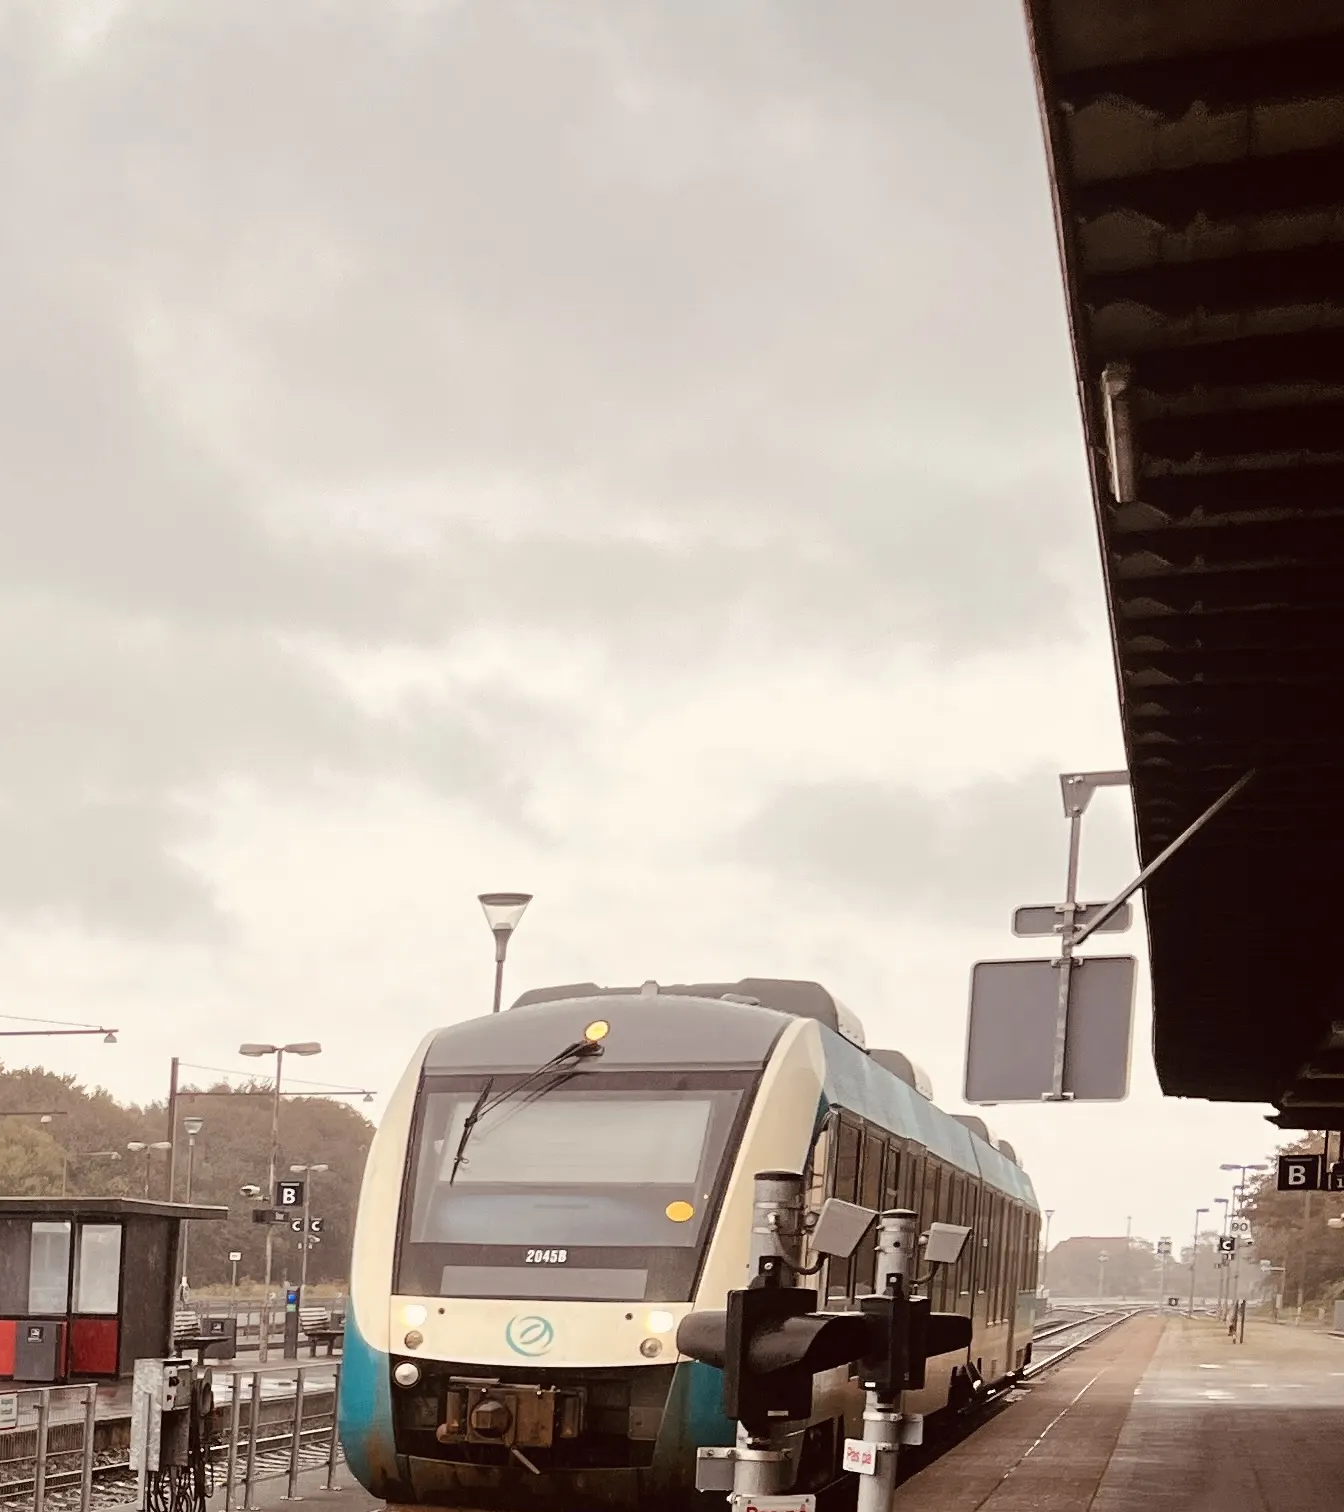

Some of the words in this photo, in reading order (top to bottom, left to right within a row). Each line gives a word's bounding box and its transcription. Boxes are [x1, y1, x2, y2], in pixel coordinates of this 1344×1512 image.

[1289, 1165, 1306, 1185] B
[282, 1187, 296, 1205] B
[291, 1220, 301, 1232] C
[311, 1220, 321, 1232] C
[1222, 1240, 1232, 1250] C
[525, 1249, 568, 1263] 2045B
[847, 1446, 860, 1463] Pas
[861, 1448, 872, 1465] på
